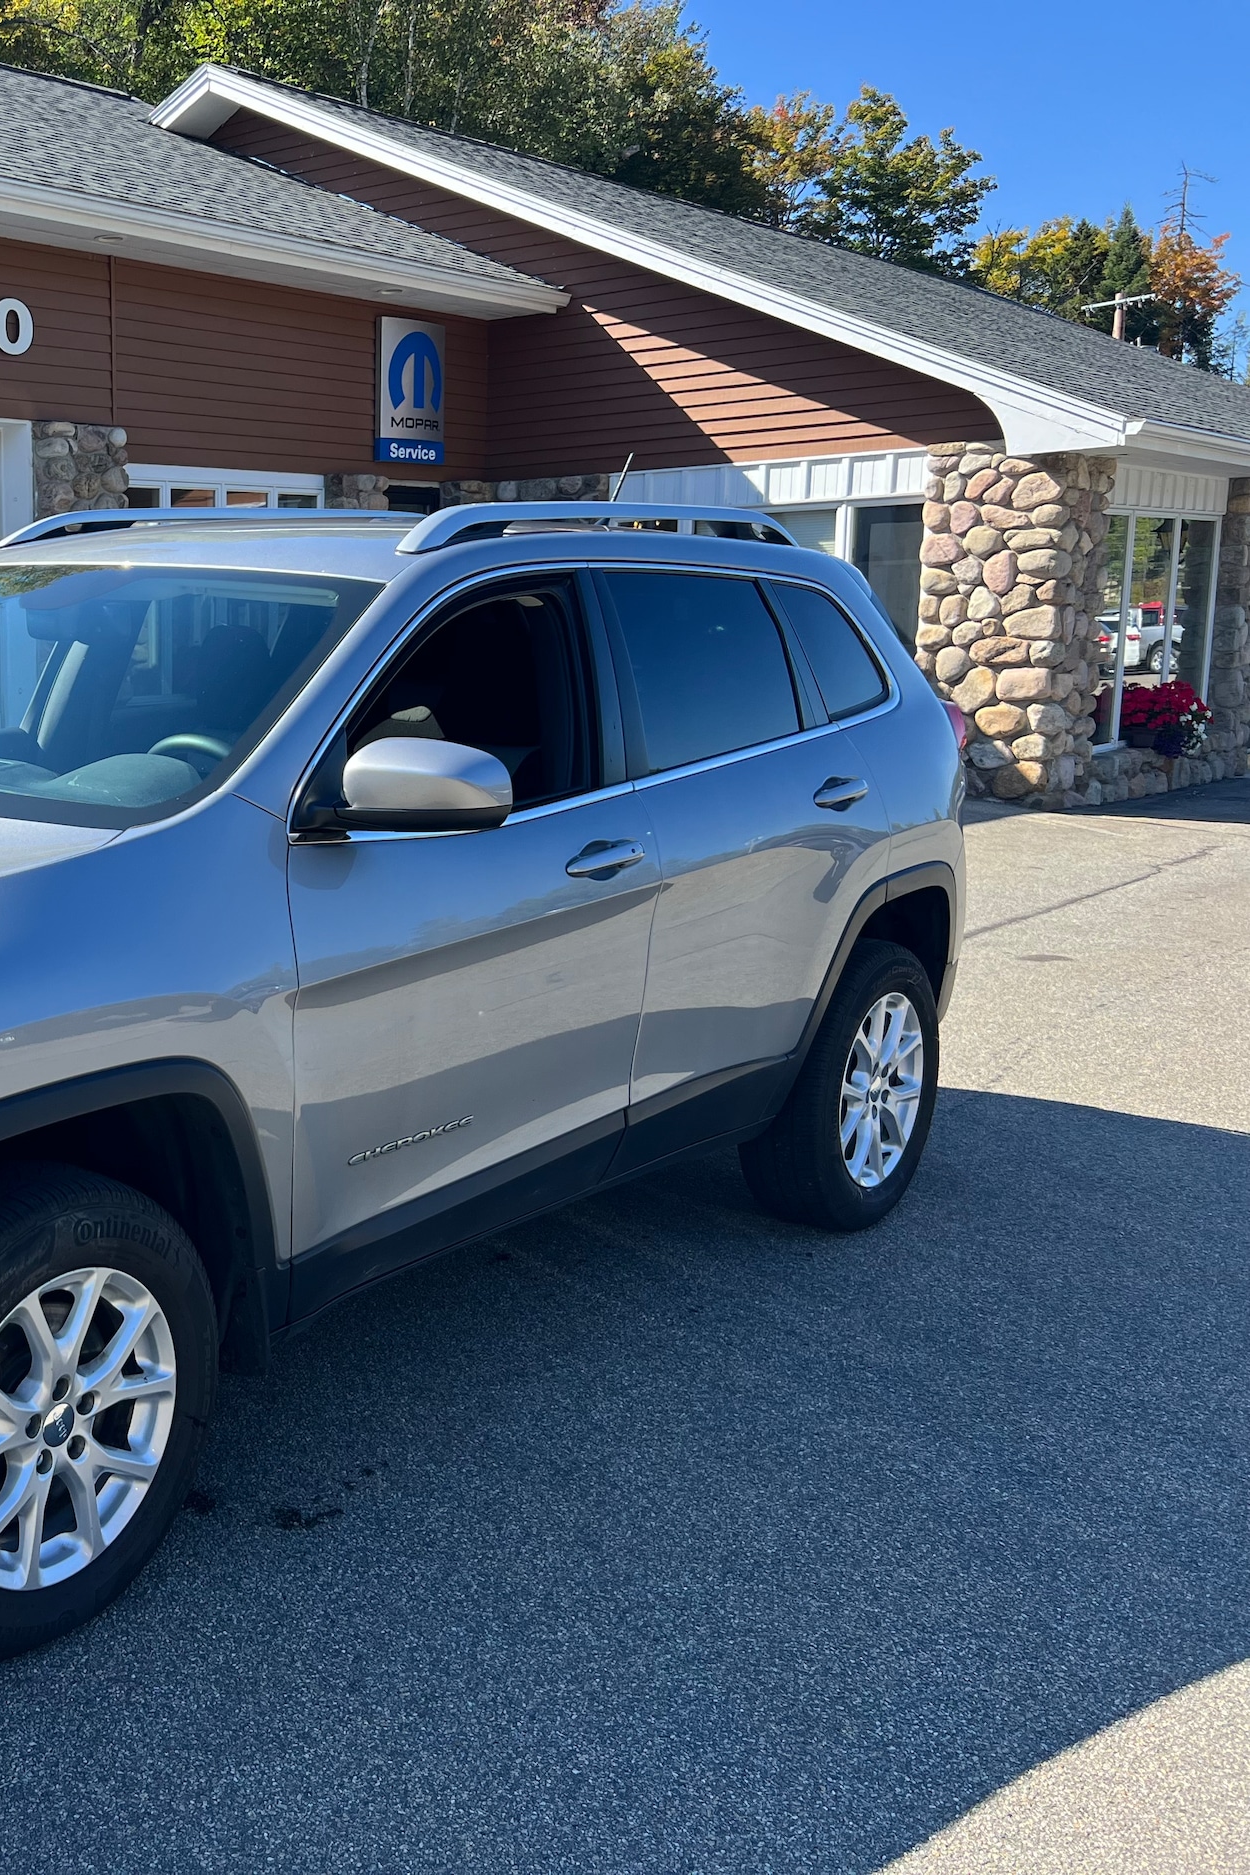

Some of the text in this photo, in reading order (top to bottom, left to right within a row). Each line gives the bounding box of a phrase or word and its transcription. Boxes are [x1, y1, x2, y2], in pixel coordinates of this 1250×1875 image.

[390, 416, 440, 431] MOPAR
[389, 442, 437, 461] Service
[348, 1114, 474, 1166] CHEROKEE
[73, 1213, 172, 1260] Continental
